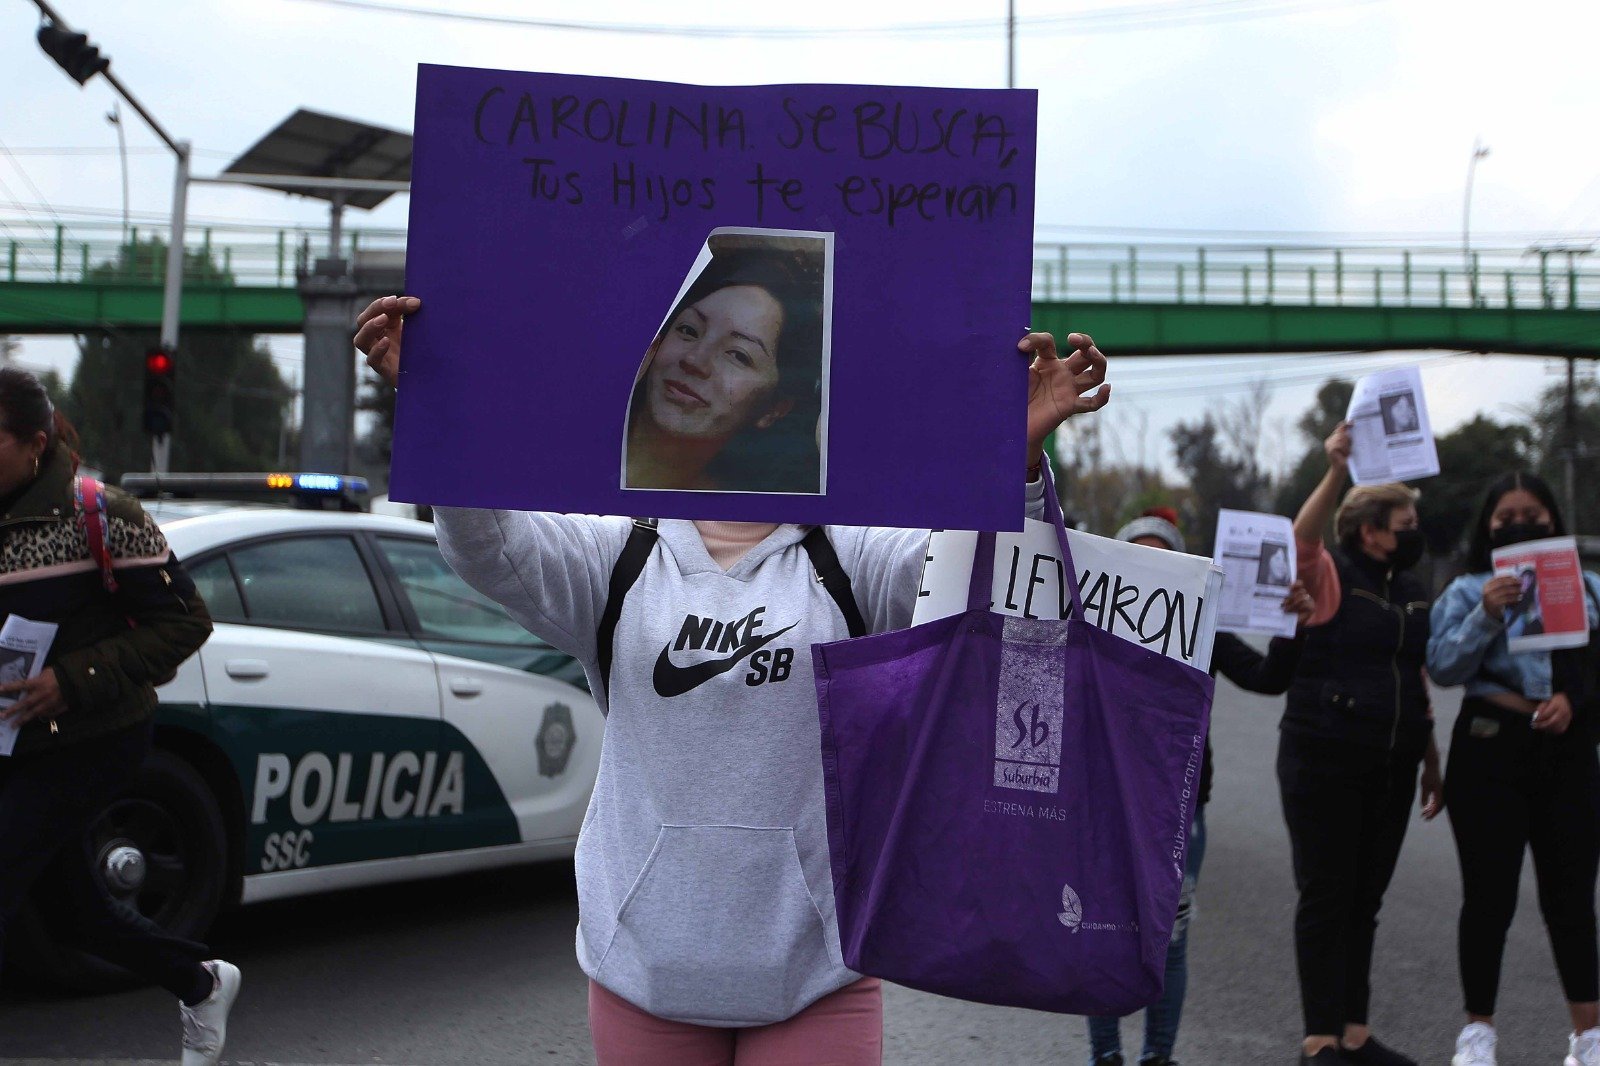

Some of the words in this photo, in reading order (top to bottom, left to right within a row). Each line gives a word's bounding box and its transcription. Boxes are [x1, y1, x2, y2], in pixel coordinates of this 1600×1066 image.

[777, 97, 838, 153] Se
[853, 101, 1018, 169] BUSCA,
[522, 157, 583, 205] Tus
[613, 160, 716, 223] Hijos
[746, 162, 804, 223] te
[835, 175, 1017, 229] esperan
[988, 545, 1203, 660] LEVARON
[673, 606, 766, 653] NIKE
[745, 647, 795, 687] SB
[1011, 699, 1050, 749] Sb
[251, 751, 465, 826] POLICIA
[1003, 766, 1051, 789] Suburbia
[984, 800, 1035, 818] ESTRENA
[1038, 805, 1068, 821] MÁS
[260, 829, 314, 872] SSC
